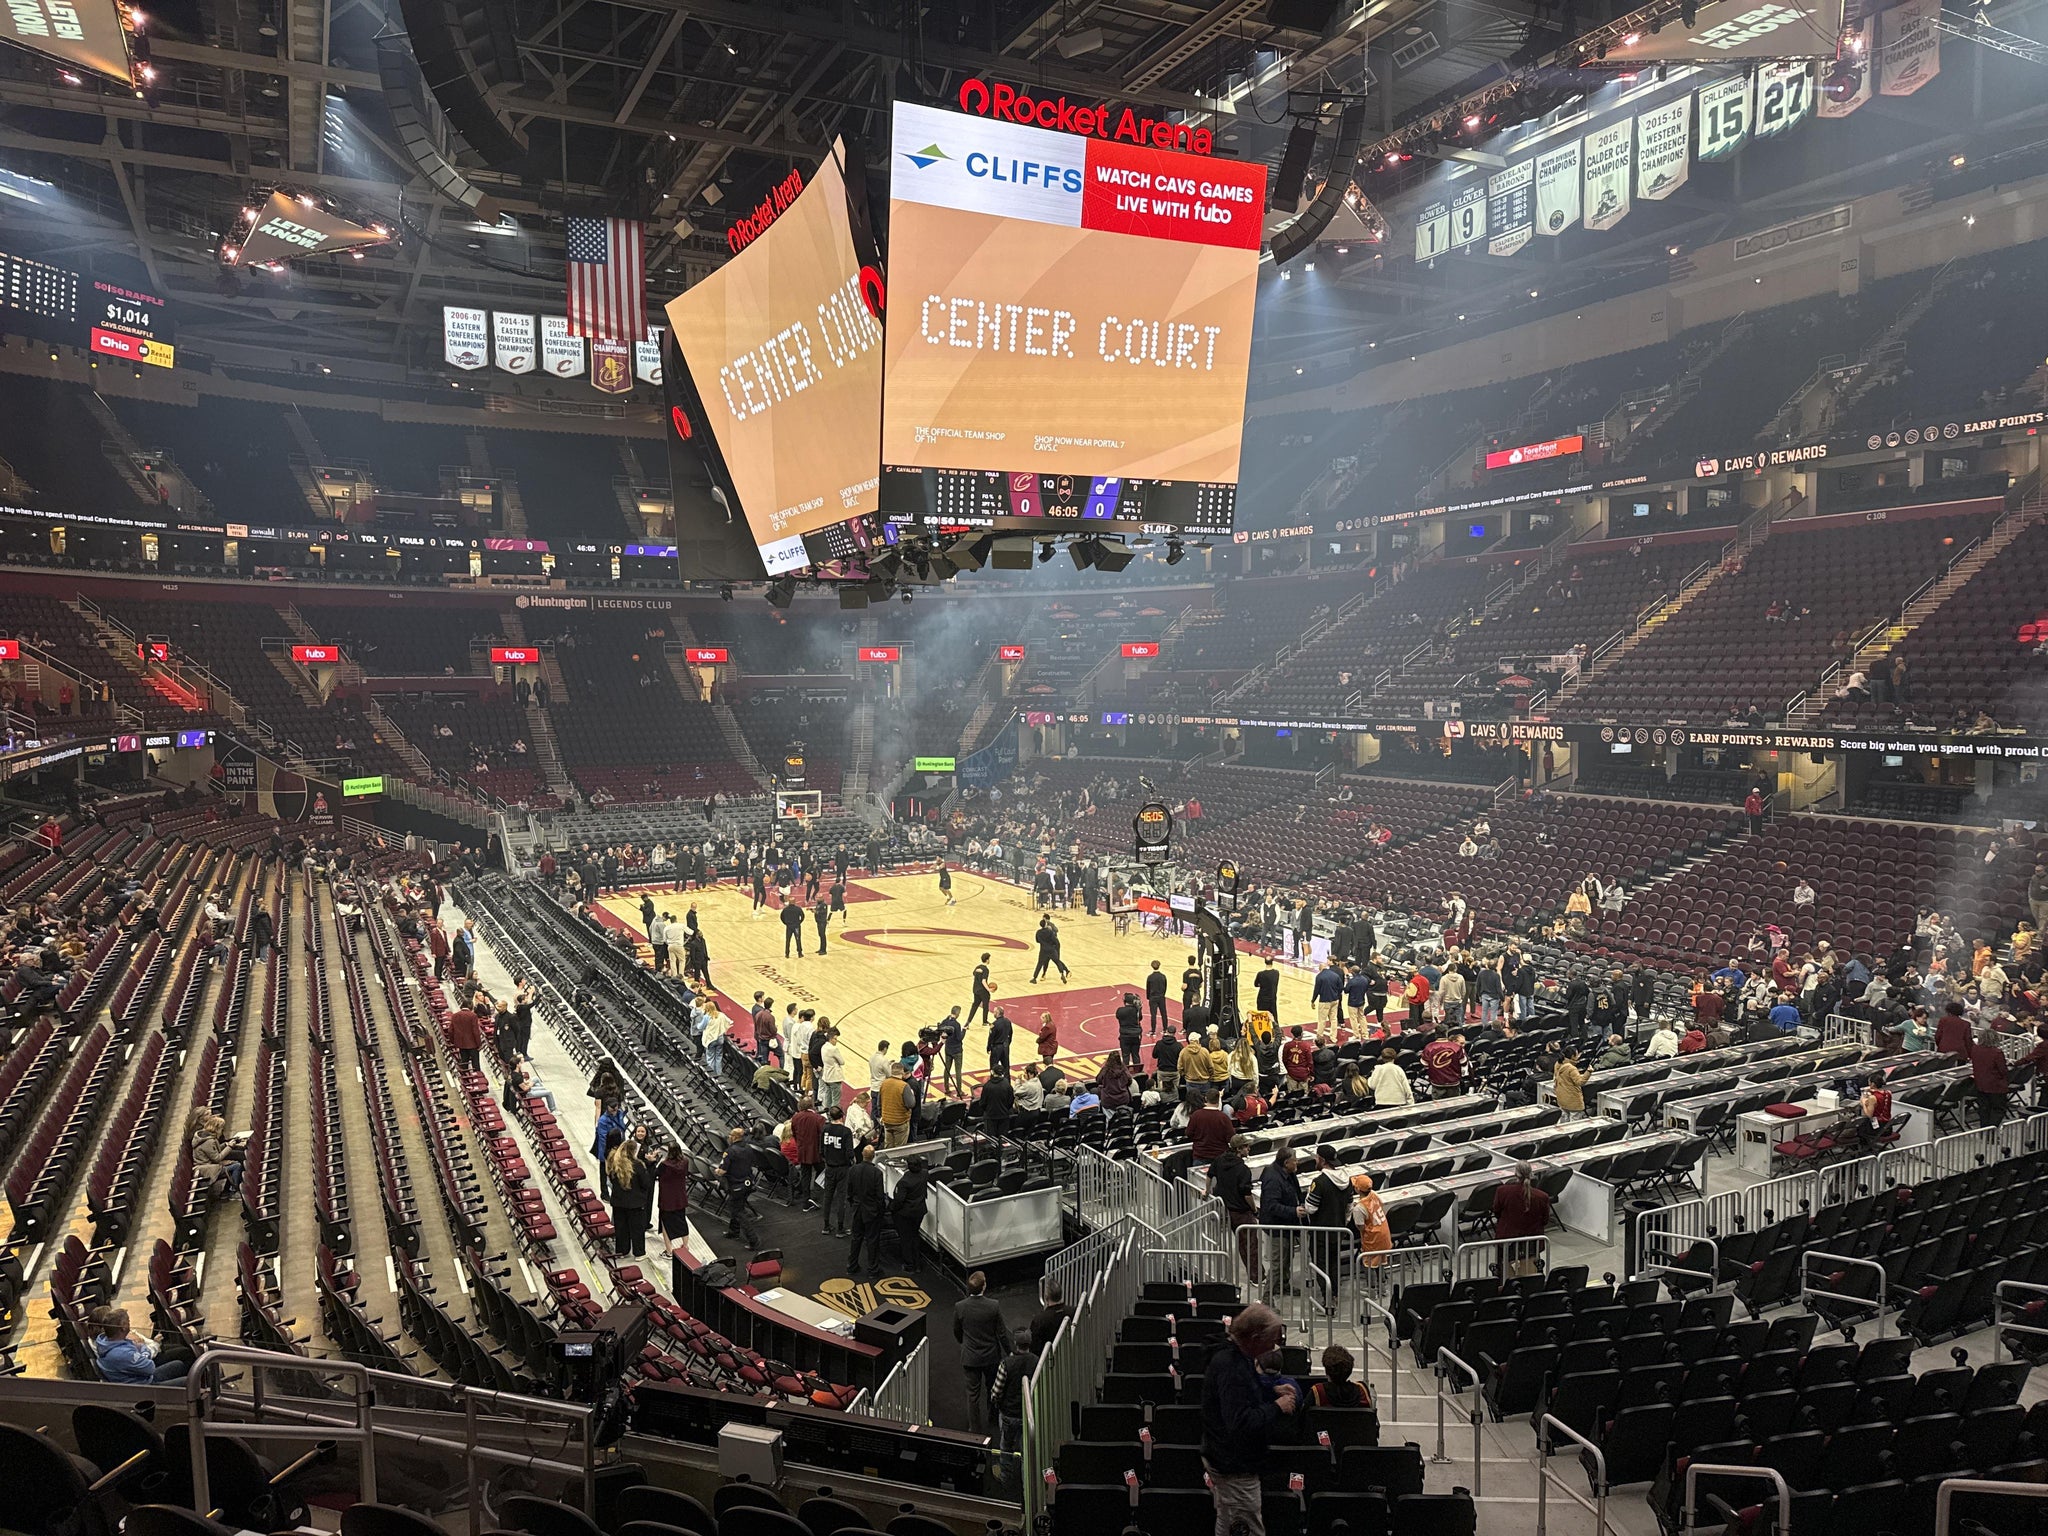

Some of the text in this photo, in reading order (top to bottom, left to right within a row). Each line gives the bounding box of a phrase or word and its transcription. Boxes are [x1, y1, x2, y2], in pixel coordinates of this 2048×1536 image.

[1688, 4, 1785, 45] LET EM
[1885, 38, 1936, 64] CHAMPIONS
[1704, 80, 1749, 105] CALLANDER
[1764, 72, 1805, 124] 27
[993, 82, 1212, 154] Rocket Arena
[1646, 107, 1682, 131] 2015-16
[1708, 96, 1743, 146] 15
[1598, 131, 1618, 148] 2016
[1646, 123, 1682, 145] WESTERN
[1641, 134, 1687, 160] CONFERENCE
[1587, 148, 1614, 167] CALDER
[1642, 148, 1684, 171] CHAMPIONS
[966, 152, 1082, 193] CLIFFS
[1490, 162, 1531, 186] CLEVELAND
[1539, 156, 1577, 179] CHAMPIONS
[1587, 155, 1629, 180] CHAMPIONS
[1096, 166, 1253, 204] WATCH CAVS GAMES
[1496, 175, 1525, 191] BARONS
[1453, 188, 1485, 208] GLOVER
[737, 168, 803, 246] Rocket Arena
[1116, 194, 1232, 224] LIVE WITH fubo
[1419, 205, 1446, 222] BOWER
[270, 217, 328, 241] LET EM
[1463, 208, 1474, 240] 9
[259, 224, 319, 249] KNOW.
[1428, 222, 1435, 253] 1
[126, 287, 164, 306] RAFFLE
[107, 304, 149, 326] $1,014
[451, 311, 481, 321] 2006-07
[499, 316, 530, 327] 2014-15
[452, 321, 481, 331] EASTERN
[501, 326, 529, 337] EASTERN
[922, 295, 1221, 370] CENTER COURT
[447, 330, 487, 341] CONFERENCE
[496, 334, 534, 345] CONFERENCE
[100, 336, 129, 352] Ohio
[449, 339, 486, 350] CHAMPIONS
[498, 343, 533, 354] CHAMPIONS
[545, 339, 582, 349] CONFERENCE
[593, 343, 628, 354] CHAMPIONS
[547, 348, 581, 357] CHAMPIONS
[720, 320, 823, 421] CENTER
[1964, 412, 2044, 433] EARN POINTS
[914, 435, 926, 444] OF
[915, 426, 1006, 442] THE OFFICIAL TEAM SHOP
[1034, 435, 1120, 450] SHOP NOW NEAR PORTAL
[1034, 443, 1058, 453] CAVS.C
[1523, 443, 1557, 455] ForeFront
[1725, 444, 1827, 471] CAVS REWARDS
[1043, 480, 1055, 489] 1Q
[1021, 499, 1030, 513] 0
[1395, 476, 1647, 522] POINTS REWARDS CAVS.COM/REWARDS
[5, 507, 15, 515] big
[16, 508, 32, 517] when
[46, 511, 63, 520] spend
[64, 512, 77, 520] with
[78, 514, 94, 523] proud
[109, 517, 133, 526] Rewards
[1049, 505, 1078, 518] 46:05
[1096, 502, 1105, 516] 0
[1873, 511, 1886, 520] 108
[957, 518, 993, 527] RAFFLE
[1143, 524, 1171, 535] $1,014
[1184, 526, 1231, 535] CAVS5050.COM
[1252, 525, 1314, 541] CAVS REWARDS
[361, 535, 644, 555] TOL 7 FOULS 46:05 0
[778, 545, 805, 561] CLIFFS
[531, 596, 672, 610] Huntington LEGENDS CLUB
[305, 649, 325, 659] fubo
[505, 651, 525, 660] fubo
[698, 651, 715, 660] fubo
[870, 651, 887, 660] fubo
[1132, 647, 1148, 655] fubo
[1069, 715, 1088, 723] 46:05
[1376, 724, 1416, 733] CAVS.COM/REWARDS
[1470, 724, 1564, 741] CAVS REWARDS
[146, 736, 170, 746] ASSISTS
[1690, 733, 1720, 744] EARN
[1722, 734, 1763, 746] POINTS
[1775, 735, 1835, 748] REWARDS
[1840, 739, 1867, 750] Score
[1869, 740, 1885, 753] big
[1888, 741, 1916, 752] when
[1919, 743, 1938, 754] you
[1941, 744, 1973, 755] spend
[1976, 745, 2001, 756] with
[2004, 746, 2039, 758] proud
[227, 776, 254, 785] PAINT
[351, 783, 371, 791] Huntington
[1140, 811, 1164, 822] 46:05
[1598, 1000, 1608, 1009] 45
[1292, 1054, 1299, 1064] 4
[1256, 1103, 1261, 1116] 1
